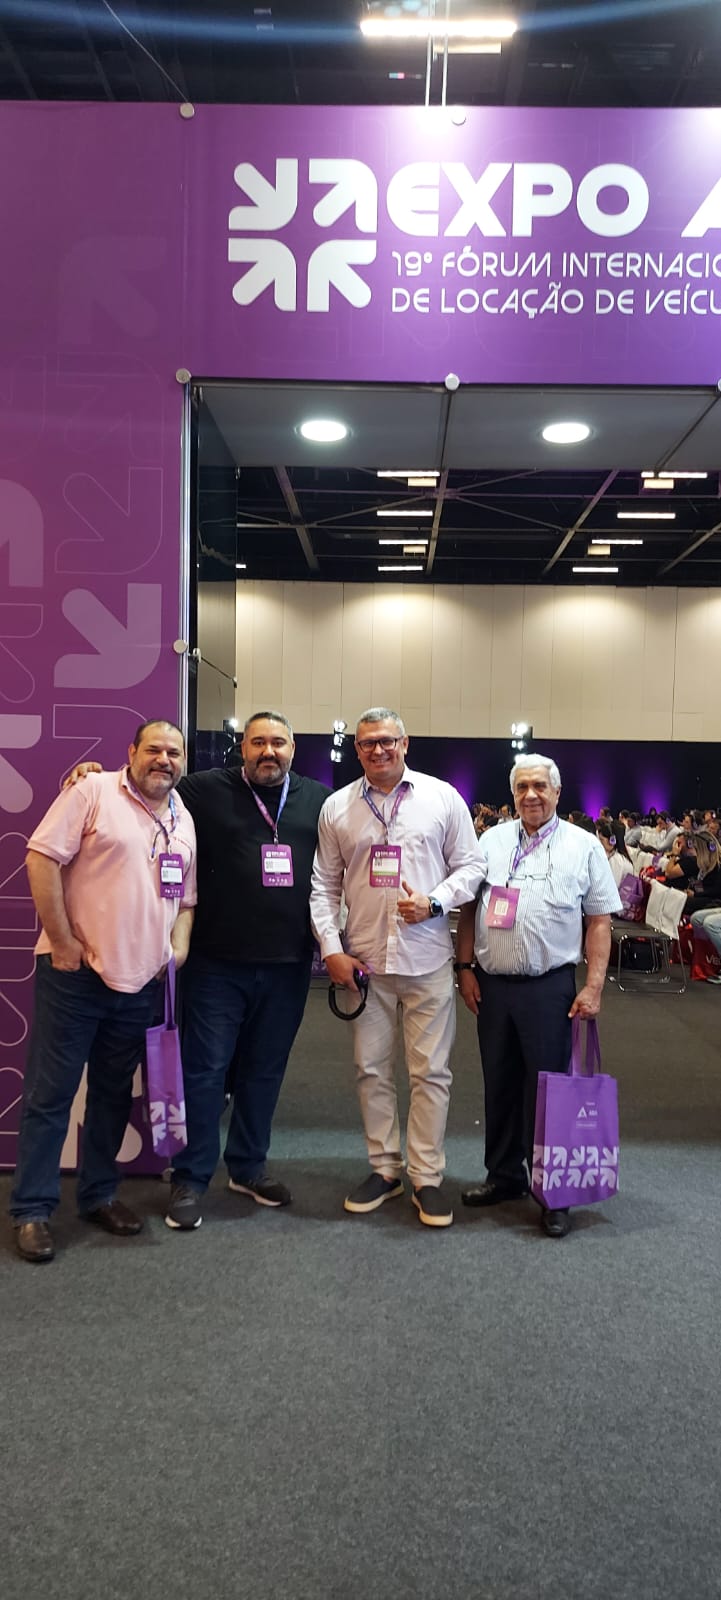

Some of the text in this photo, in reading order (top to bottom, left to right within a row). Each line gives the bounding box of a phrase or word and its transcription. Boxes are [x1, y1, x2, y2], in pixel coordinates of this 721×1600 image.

[386, 161, 650, 238] EXPO
[442, 245, 552, 278] FÓRUM
[391, 287, 431, 314] DE
[441, 282, 584, 319] LOCAÇÃO
[595, 289, 635, 315] DE
